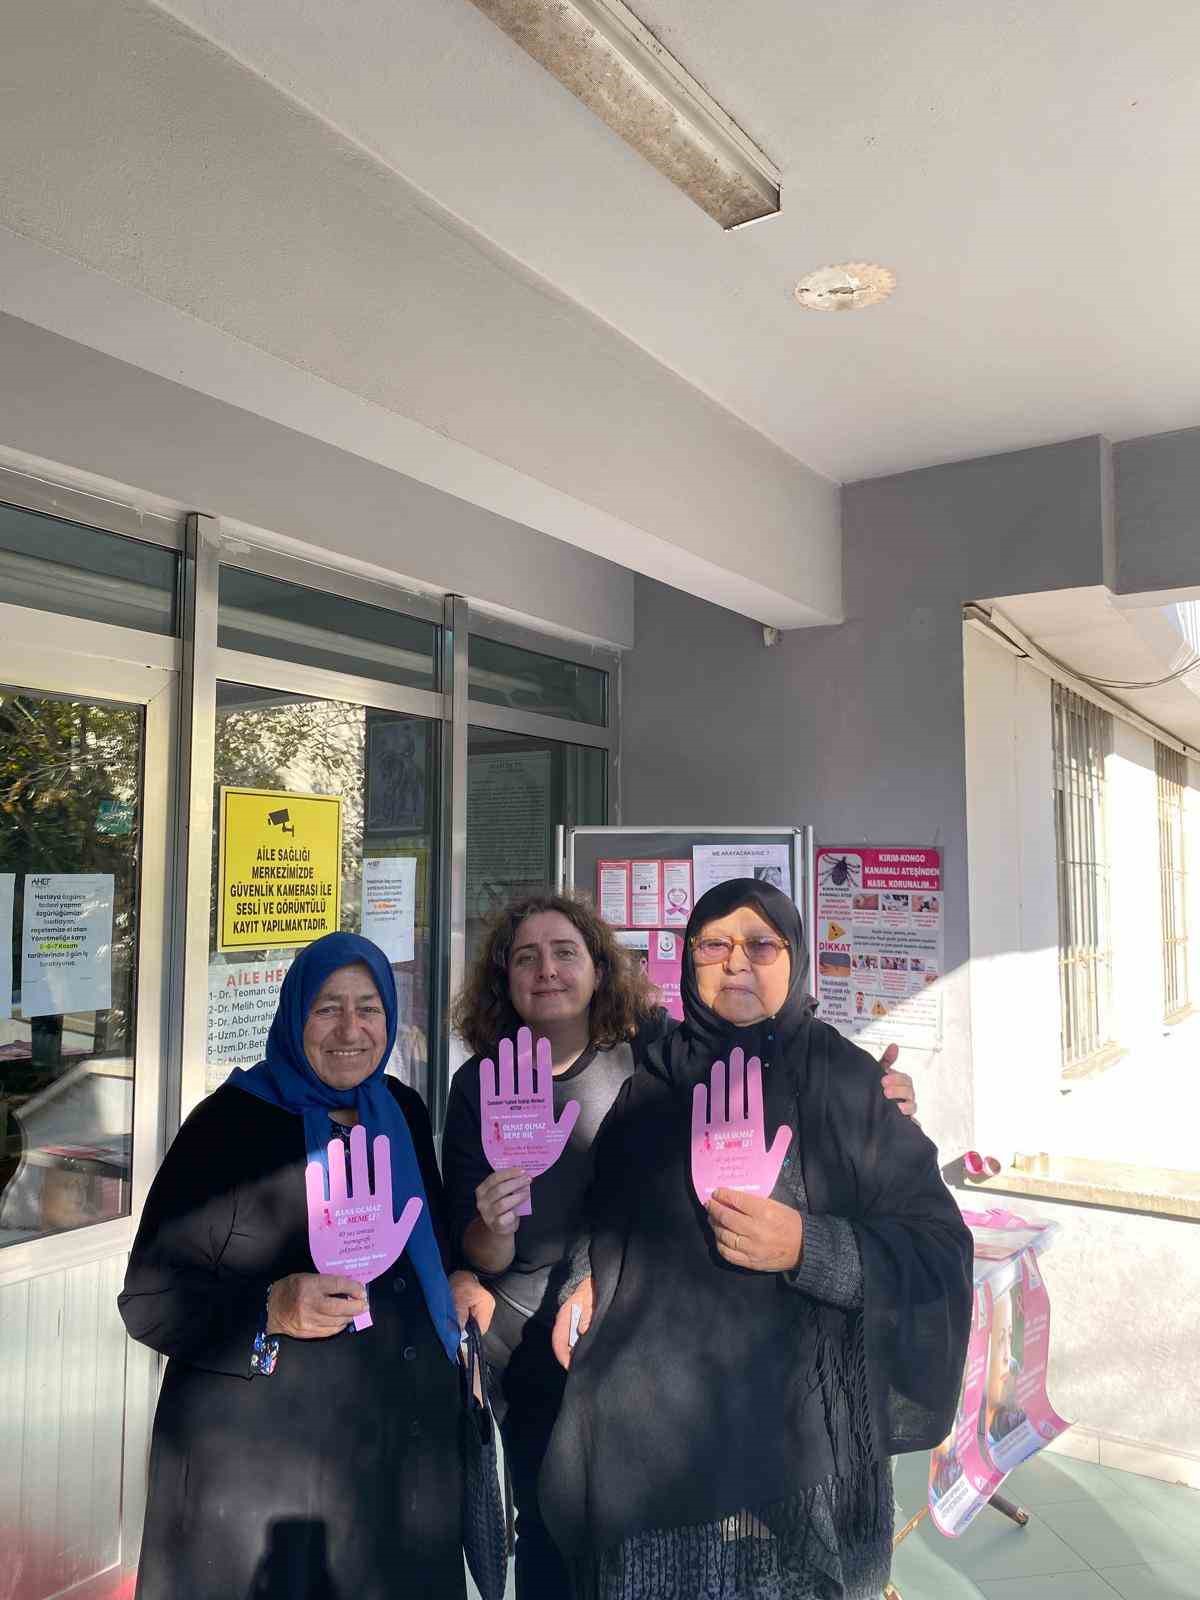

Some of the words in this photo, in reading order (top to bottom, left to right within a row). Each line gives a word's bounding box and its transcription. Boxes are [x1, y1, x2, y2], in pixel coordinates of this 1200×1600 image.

[257, 845, 275, 861] AİLE
[278, 846, 310, 861] SAĞLIĞI
[252, 864, 314, 879] MERKEZİMİZDE
[230, 881, 274, 897] GÜVENLİK
[277, 883, 318, 896] KAMERASI
[320, 881, 332, 896] İLE
[236, 899, 261, 915] SESLİ
[263, 902, 274, 914] VE
[276, 898, 326, 914] GÖRÜNTÜLÜ
[233, 920, 259, 934] KAYIT
[262, 918, 328, 933] YAPILMAKTADIR.
[818, 941, 852, 952] DİKKAT
[226, 969, 260, 987] AİLE
[265, 968, 288, 983] HE
[234, 987, 266, 999] Teoman
[232, 1001, 255, 1013] Melih
[256, 999, 277, 1010] Onur
